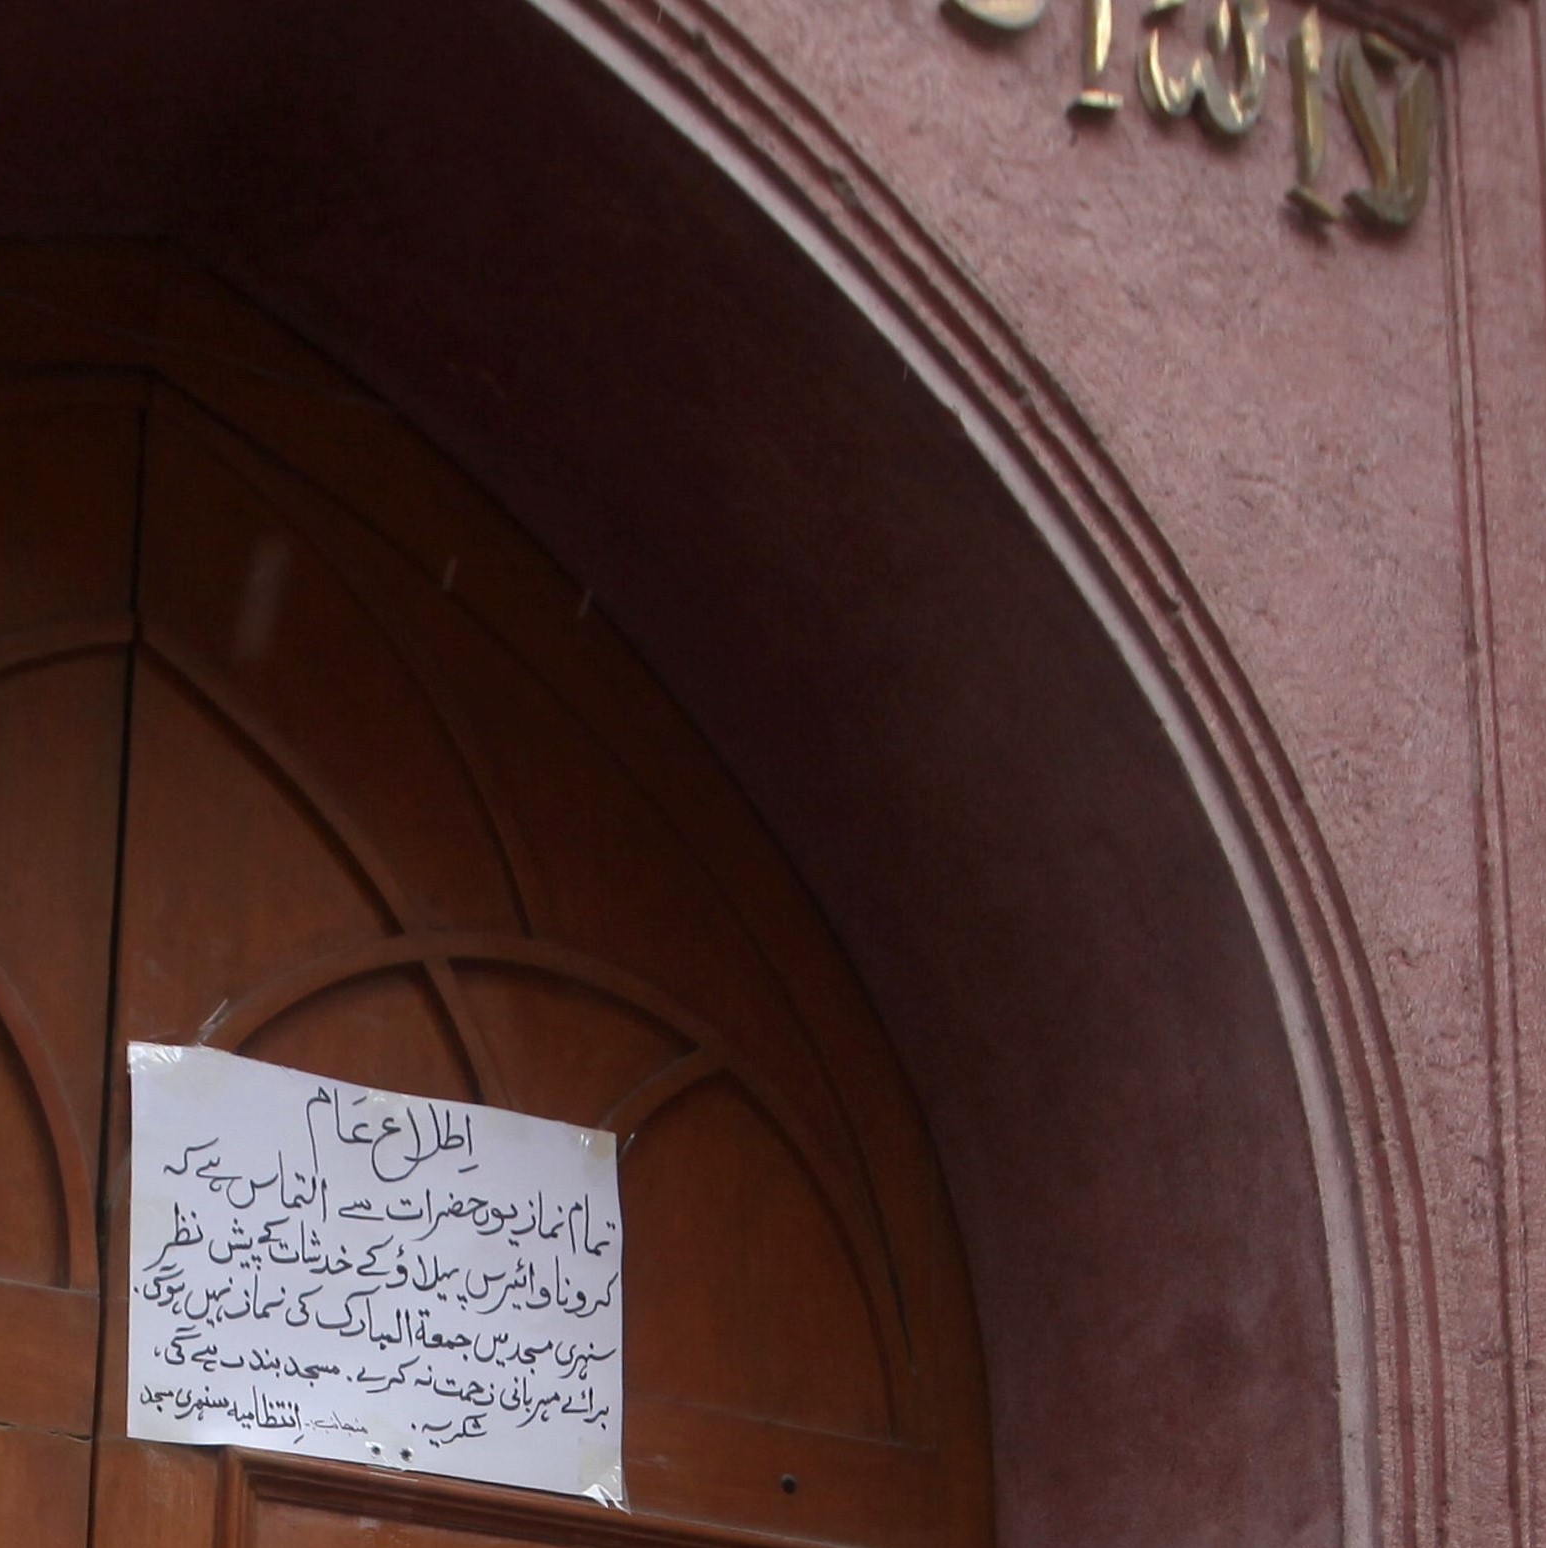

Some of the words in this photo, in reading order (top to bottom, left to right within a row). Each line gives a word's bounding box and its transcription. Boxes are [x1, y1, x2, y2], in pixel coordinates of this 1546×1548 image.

[163, 1137, 219, 1175] کہ
[196, 1156, 243, 1192] ہے
[226, 1149, 328, 1223] التماس
[257, 1216, 290, 1244] کے
[338, 1199, 384, 1221] سے
[383, 1188, 489, 1241] حضرات
[568, 1194, 616, 1256] تمام
[142, 1202, 204, 1272] نظر
[208, 1218, 262, 1270] پیش
[268, 1220, 353, 1275] خدشات
[356, 1235, 394, 1276] کے
[184, 1276, 233, 1329] نہیں
[223, 1273, 286, 1319] نماز
[285, 1285, 324, 1327] کی
[555, 1255, 619, 1318] کرونا
[315, 1285, 414, 1351] المبارک
[249, 1348, 282, 1379] بند
[473, 1332, 509, 1368] میں
[505, 1340, 553, 1375] مسجد
[555, 1341, 617, 1380] سنہری
[284, 1355, 341, 1388] مسجد
[414, 1364, 434, 1388] نہ
[433, 1378, 495, 1406] زحمت
[139, 1384, 174, 1413] مسجد
[174, 1385, 229, 1421] سنہری
[500, 1376, 562, 1428] مہربانی
[561, 1386, 610, 1430] برائے
